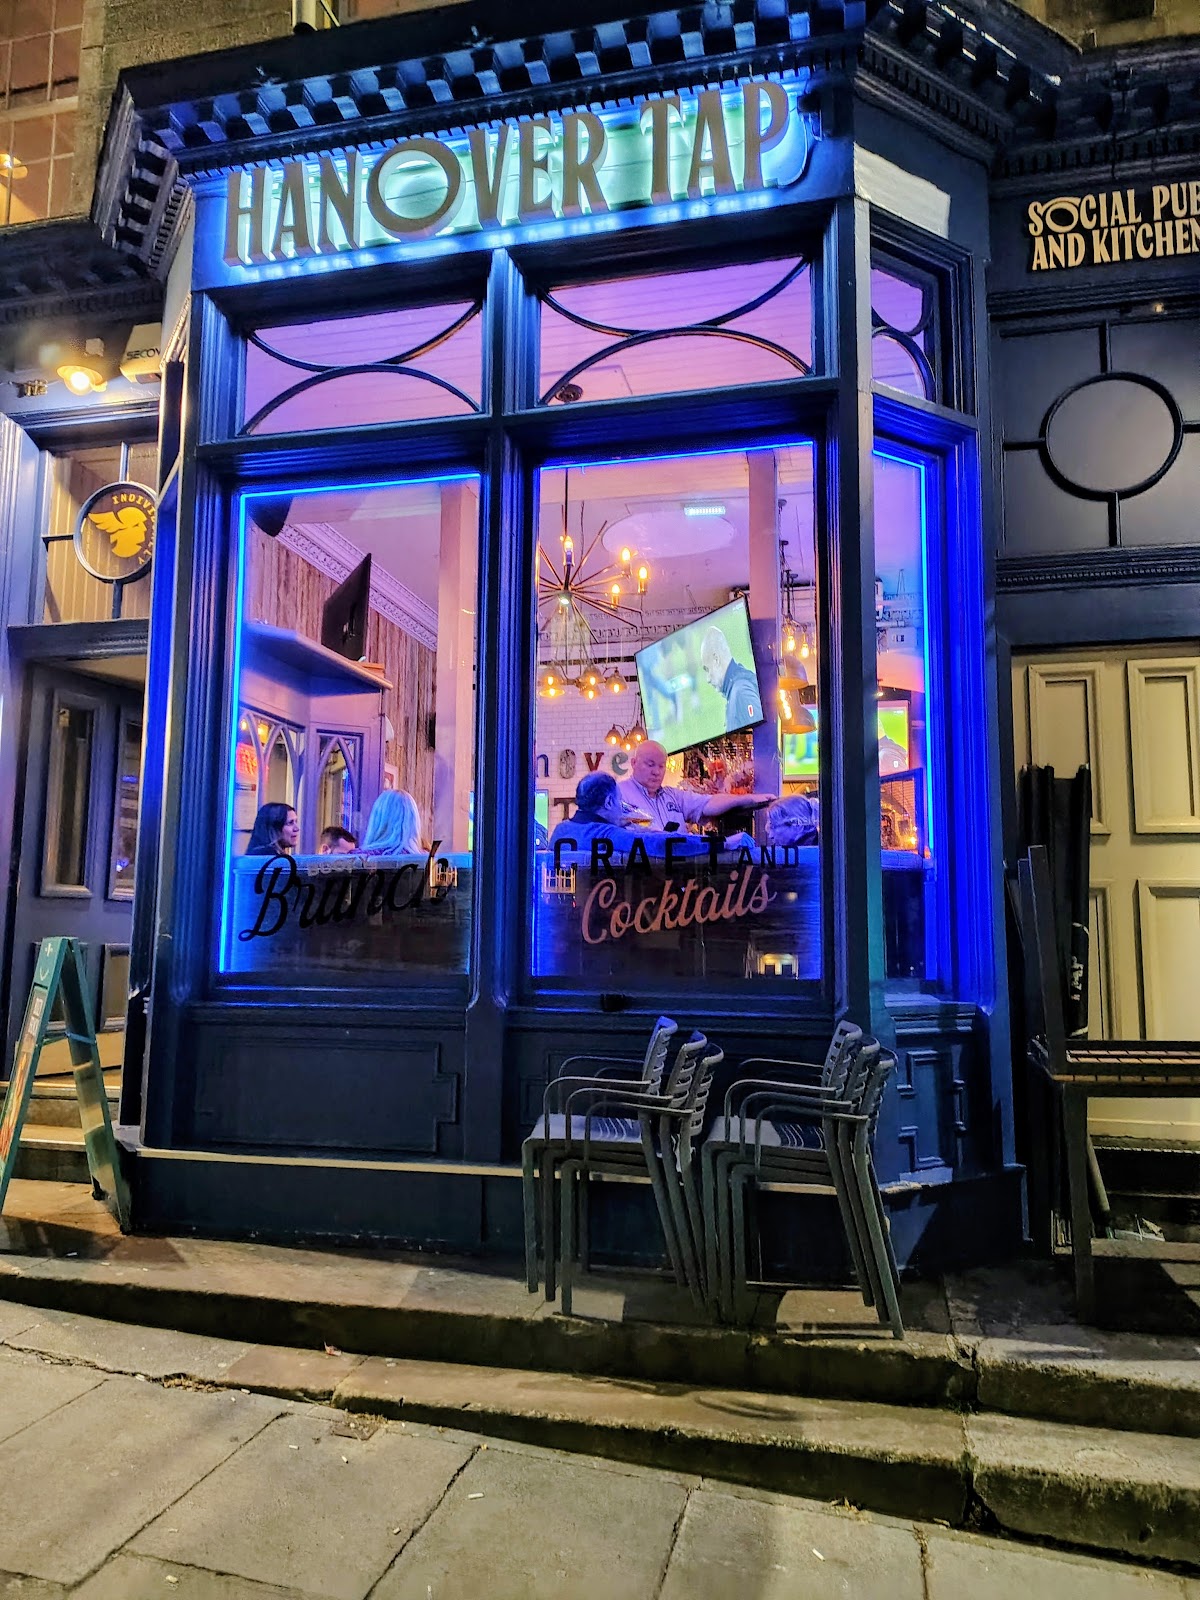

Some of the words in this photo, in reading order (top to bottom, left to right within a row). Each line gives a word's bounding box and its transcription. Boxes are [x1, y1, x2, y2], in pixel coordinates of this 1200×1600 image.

[224, 111, 608, 266] HANOVER
[640, 81, 790, 204] TAP
[1028, 188, 1142, 237] SOCIAL
[1152, 181, 1200, 221] PUB
[1032, 232, 1086, 271] AND
[553, 834, 727, 877] CRAFT
[736, 844, 799, 869] AND
[238, 840, 458, 941] Brunch
[581, 864, 778, 945] Cocktails
